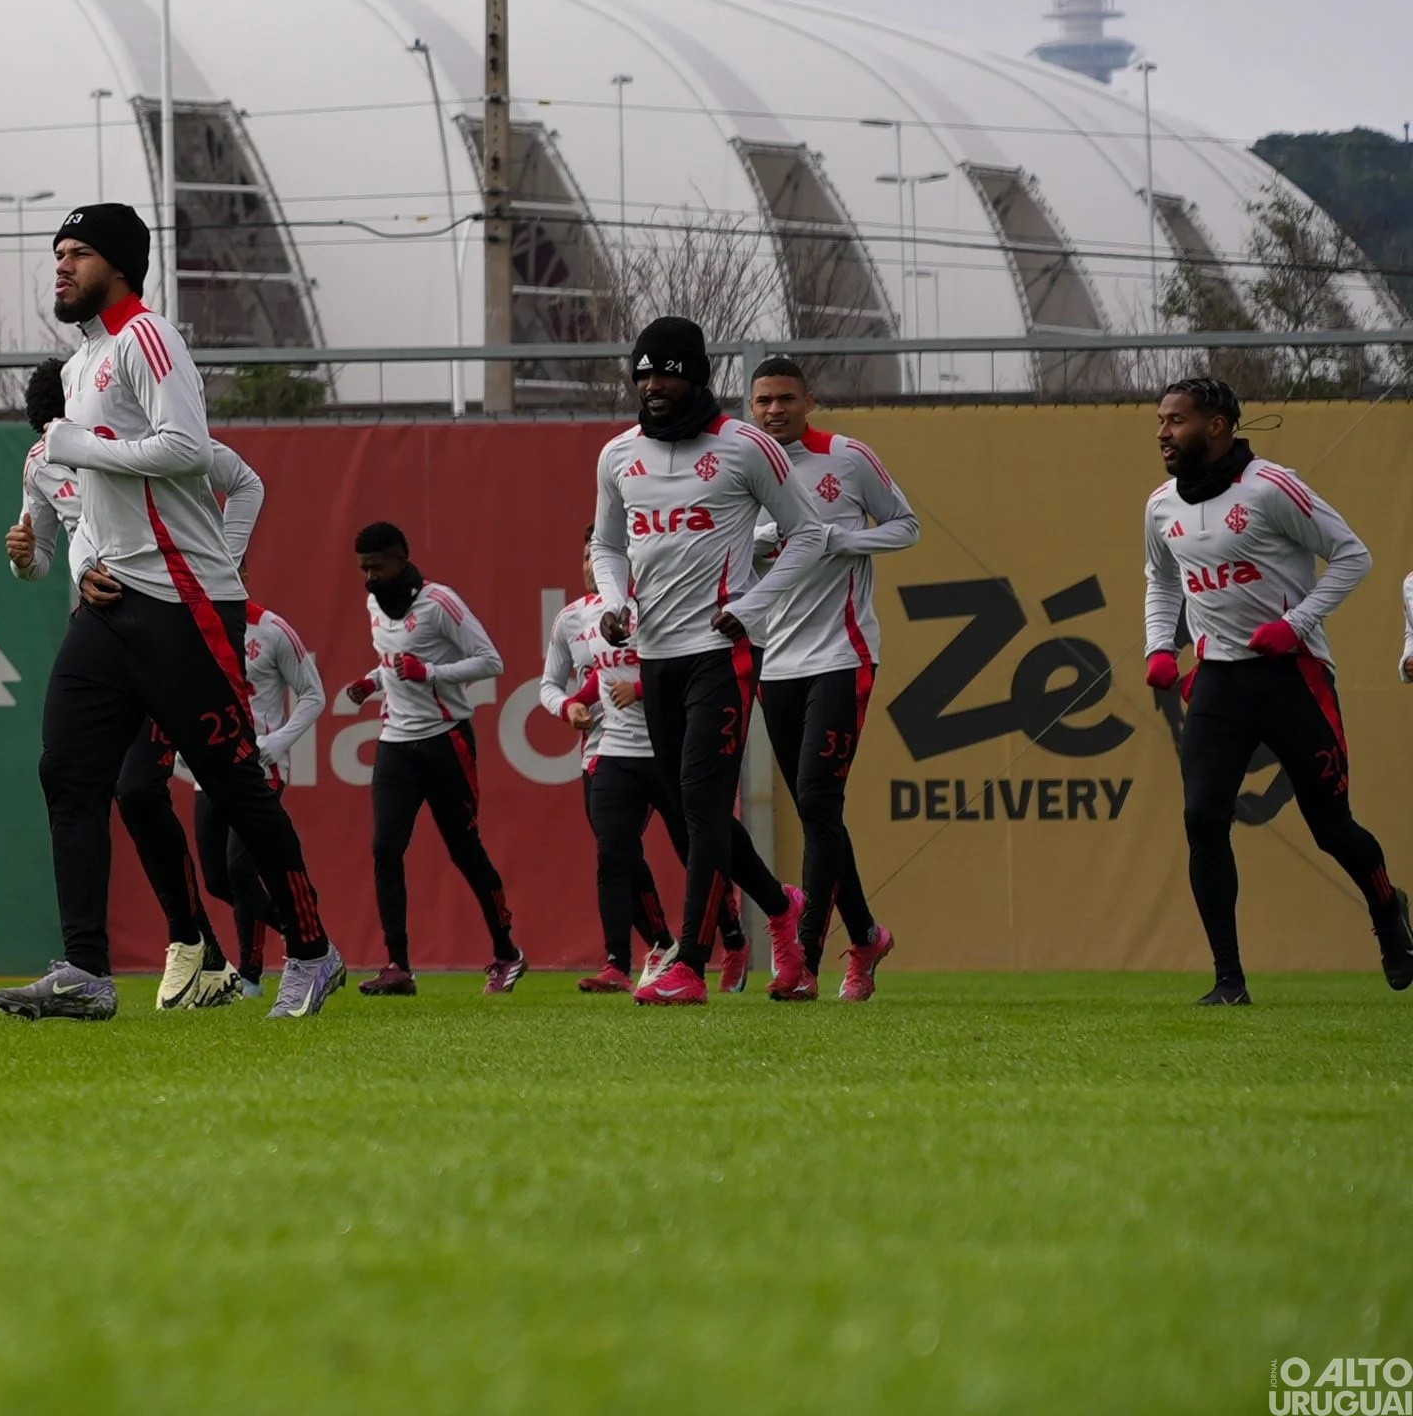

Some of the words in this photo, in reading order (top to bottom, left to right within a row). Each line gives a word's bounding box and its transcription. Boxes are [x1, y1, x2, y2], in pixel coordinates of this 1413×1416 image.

[663, 359, 683, 374] 24
[632, 506, 715, 535] alfa
[1186, 560, 1261, 594] alfa
[886, 573, 1136, 762] Zé
[199, 704, 241, 746] 23
[819, 729, 852, 761] 33
[890, 778, 1134, 822] DELIVERY
